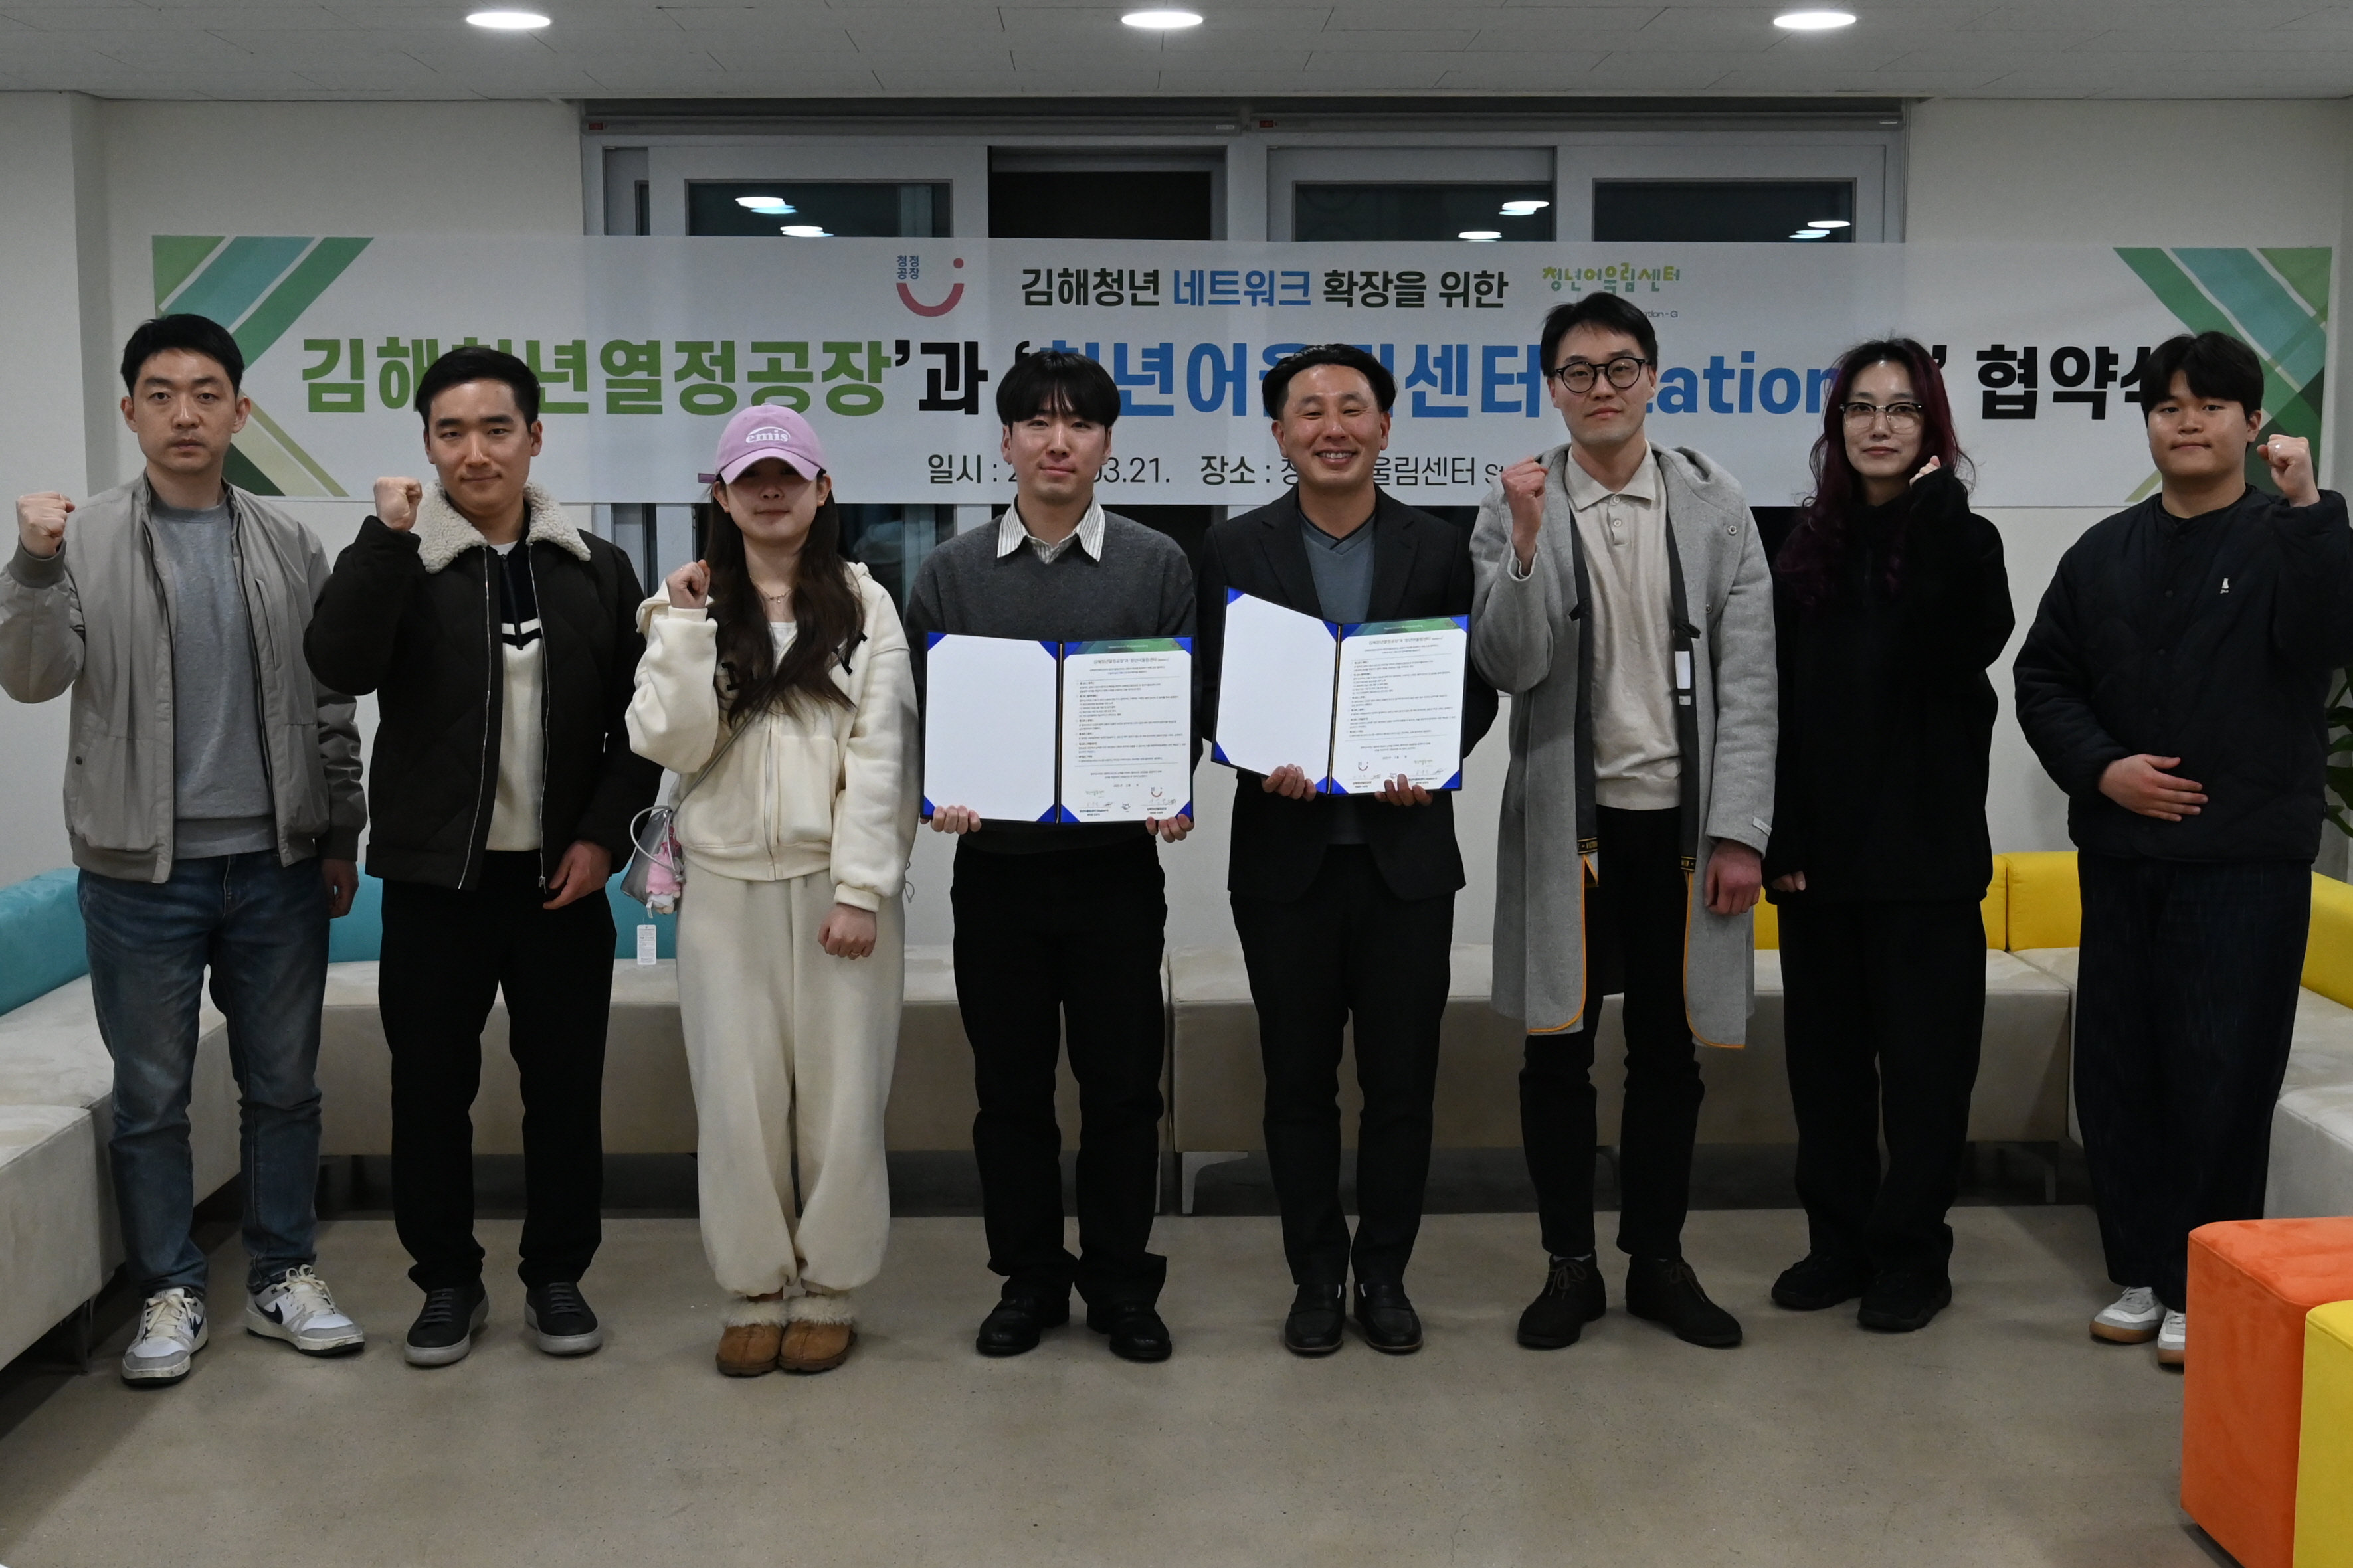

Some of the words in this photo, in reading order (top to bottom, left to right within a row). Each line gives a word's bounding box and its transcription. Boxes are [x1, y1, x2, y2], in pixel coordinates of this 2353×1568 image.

[897, 255, 919, 267] 청정
[897, 268, 919, 280] 공장
[1543, 262, 1680, 294] 청년어울림센터
[1021, 268, 1160, 307] 김해청년
[1173, 270, 1311, 307] 네트워크
[1323, 270, 1427, 308] 확장을
[1438, 270, 1509, 308] 위한
[745, 429, 789, 443] emis
[928, 454, 981, 484] 일시
[1200, 456, 1255, 485] 장소
